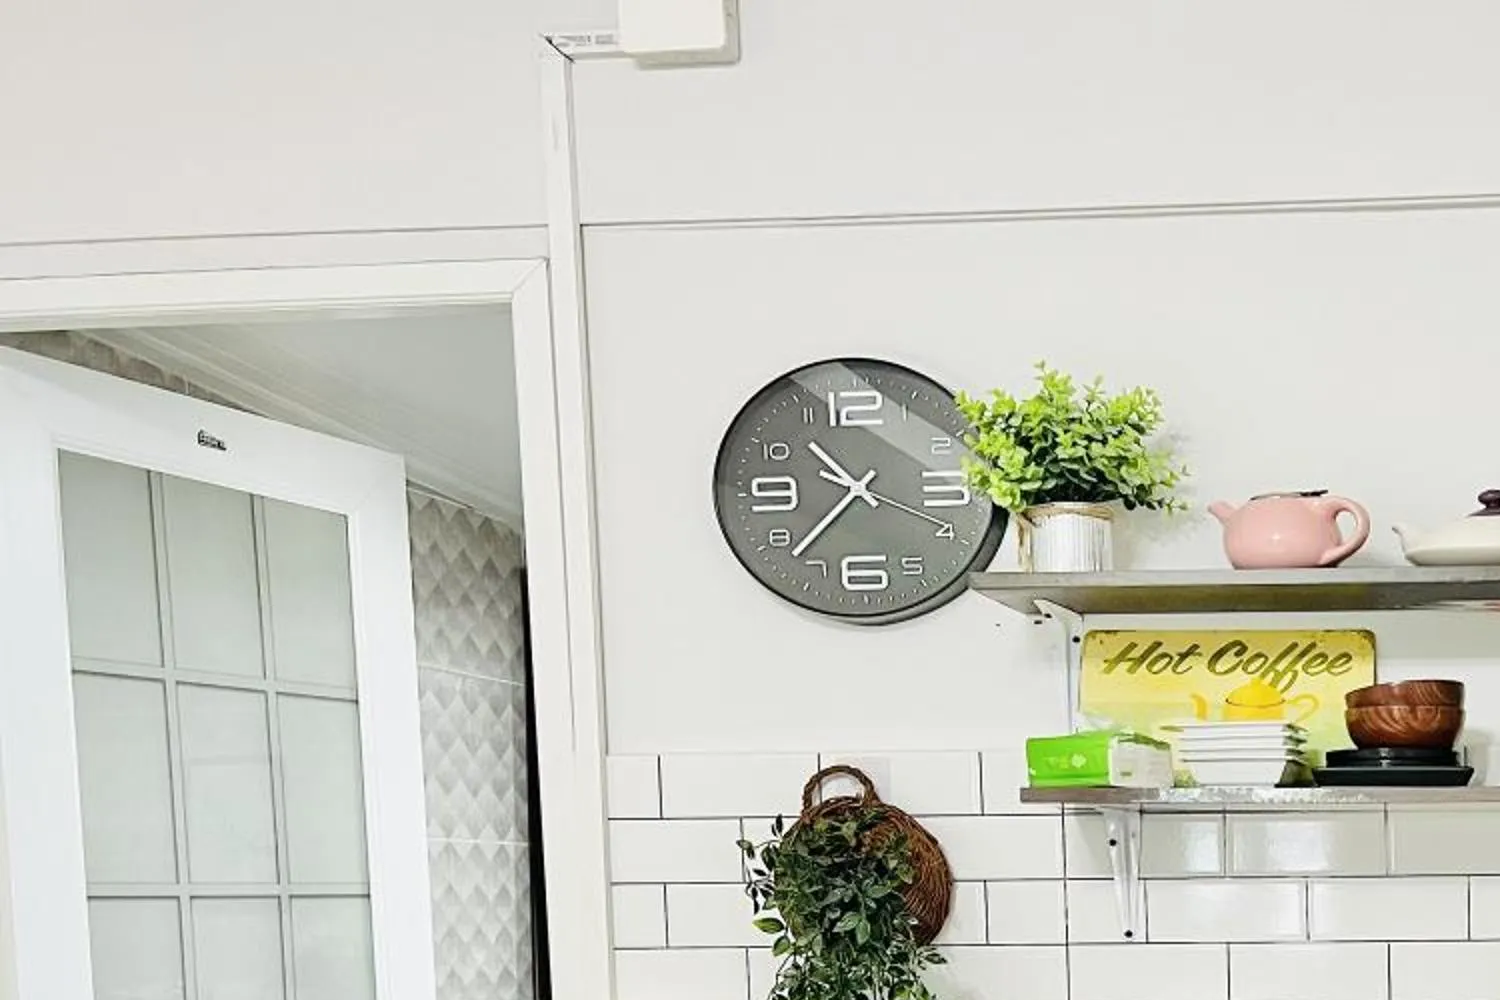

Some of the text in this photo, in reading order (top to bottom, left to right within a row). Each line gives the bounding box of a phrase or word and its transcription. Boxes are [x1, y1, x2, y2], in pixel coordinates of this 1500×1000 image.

[828, 390, 884, 427] 12
[903, 404, 908, 422] 1
[763, 443, 790, 461] 10
[931, 437, 951, 455] 2
[751, 475, 798, 512] 9
[921, 470, 971, 507] 3
[769, 529, 790, 547] 8
[935, 524, 955, 540] 4
[805, 560, 827, 578] 7
[841, 554, 888, 591] 6
[901, 557, 923, 575] 5
[1103, 639, 1353, 695] Hot Coffee
